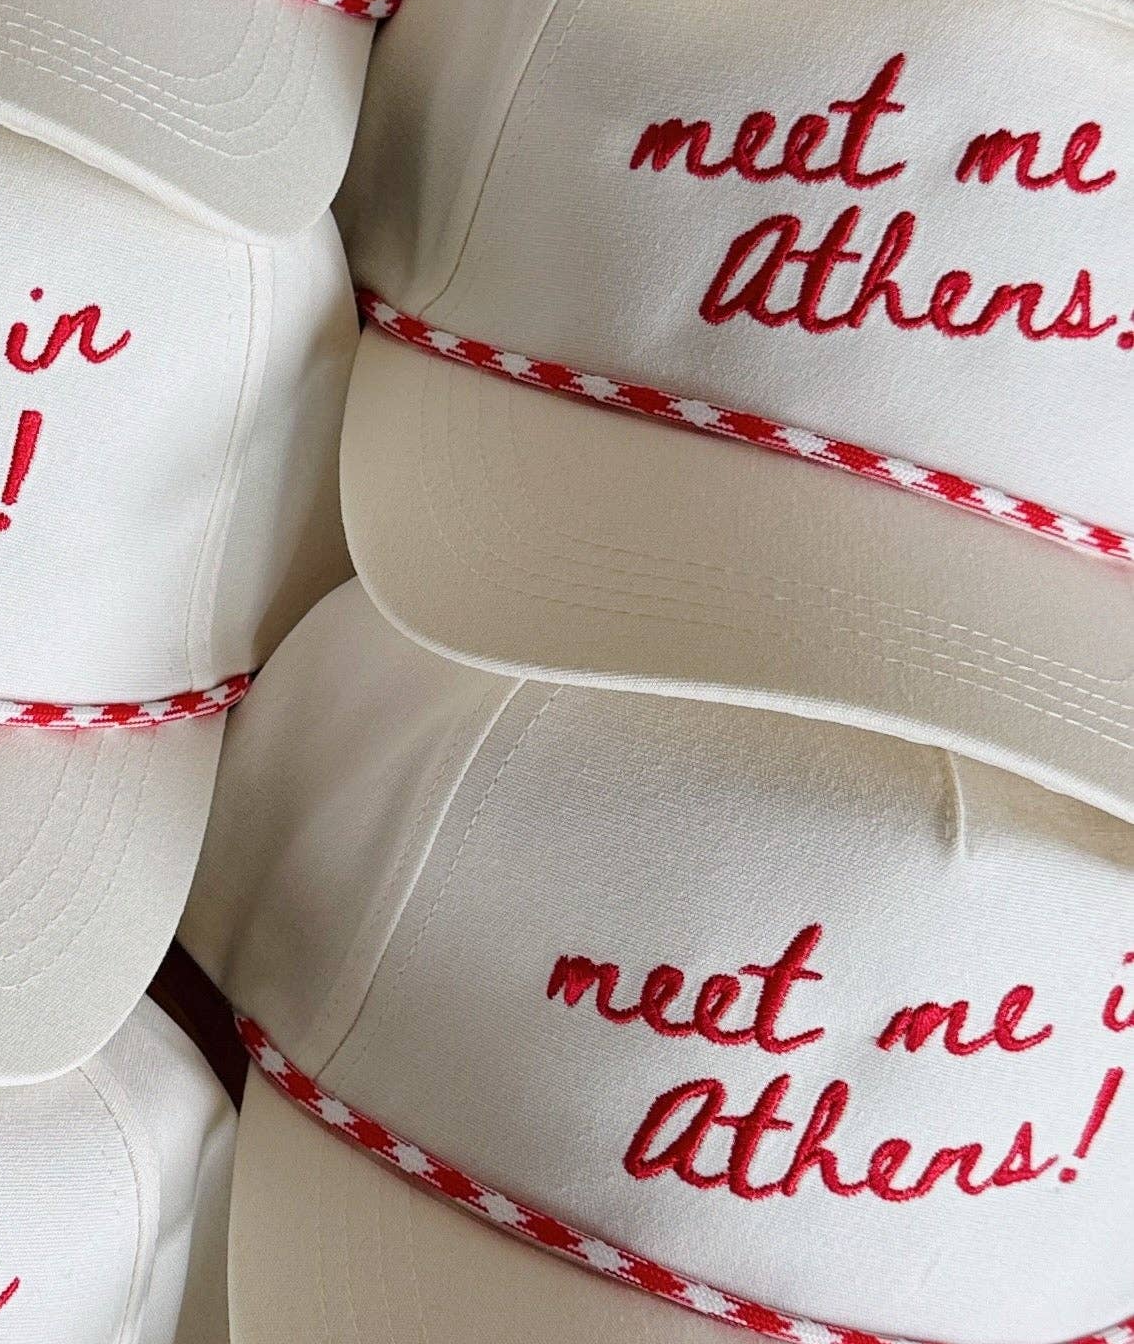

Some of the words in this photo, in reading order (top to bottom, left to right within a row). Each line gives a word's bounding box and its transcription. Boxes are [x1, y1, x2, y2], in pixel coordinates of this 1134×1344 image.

[630, 53, 905, 190] meet
[956, 122, 1116, 193] me
[5, 288, 131, 374] in
[547, 924, 823, 1054] meet
[876, 985, 1052, 1056] me
[623, 1068, 1123, 1202] Athens!
